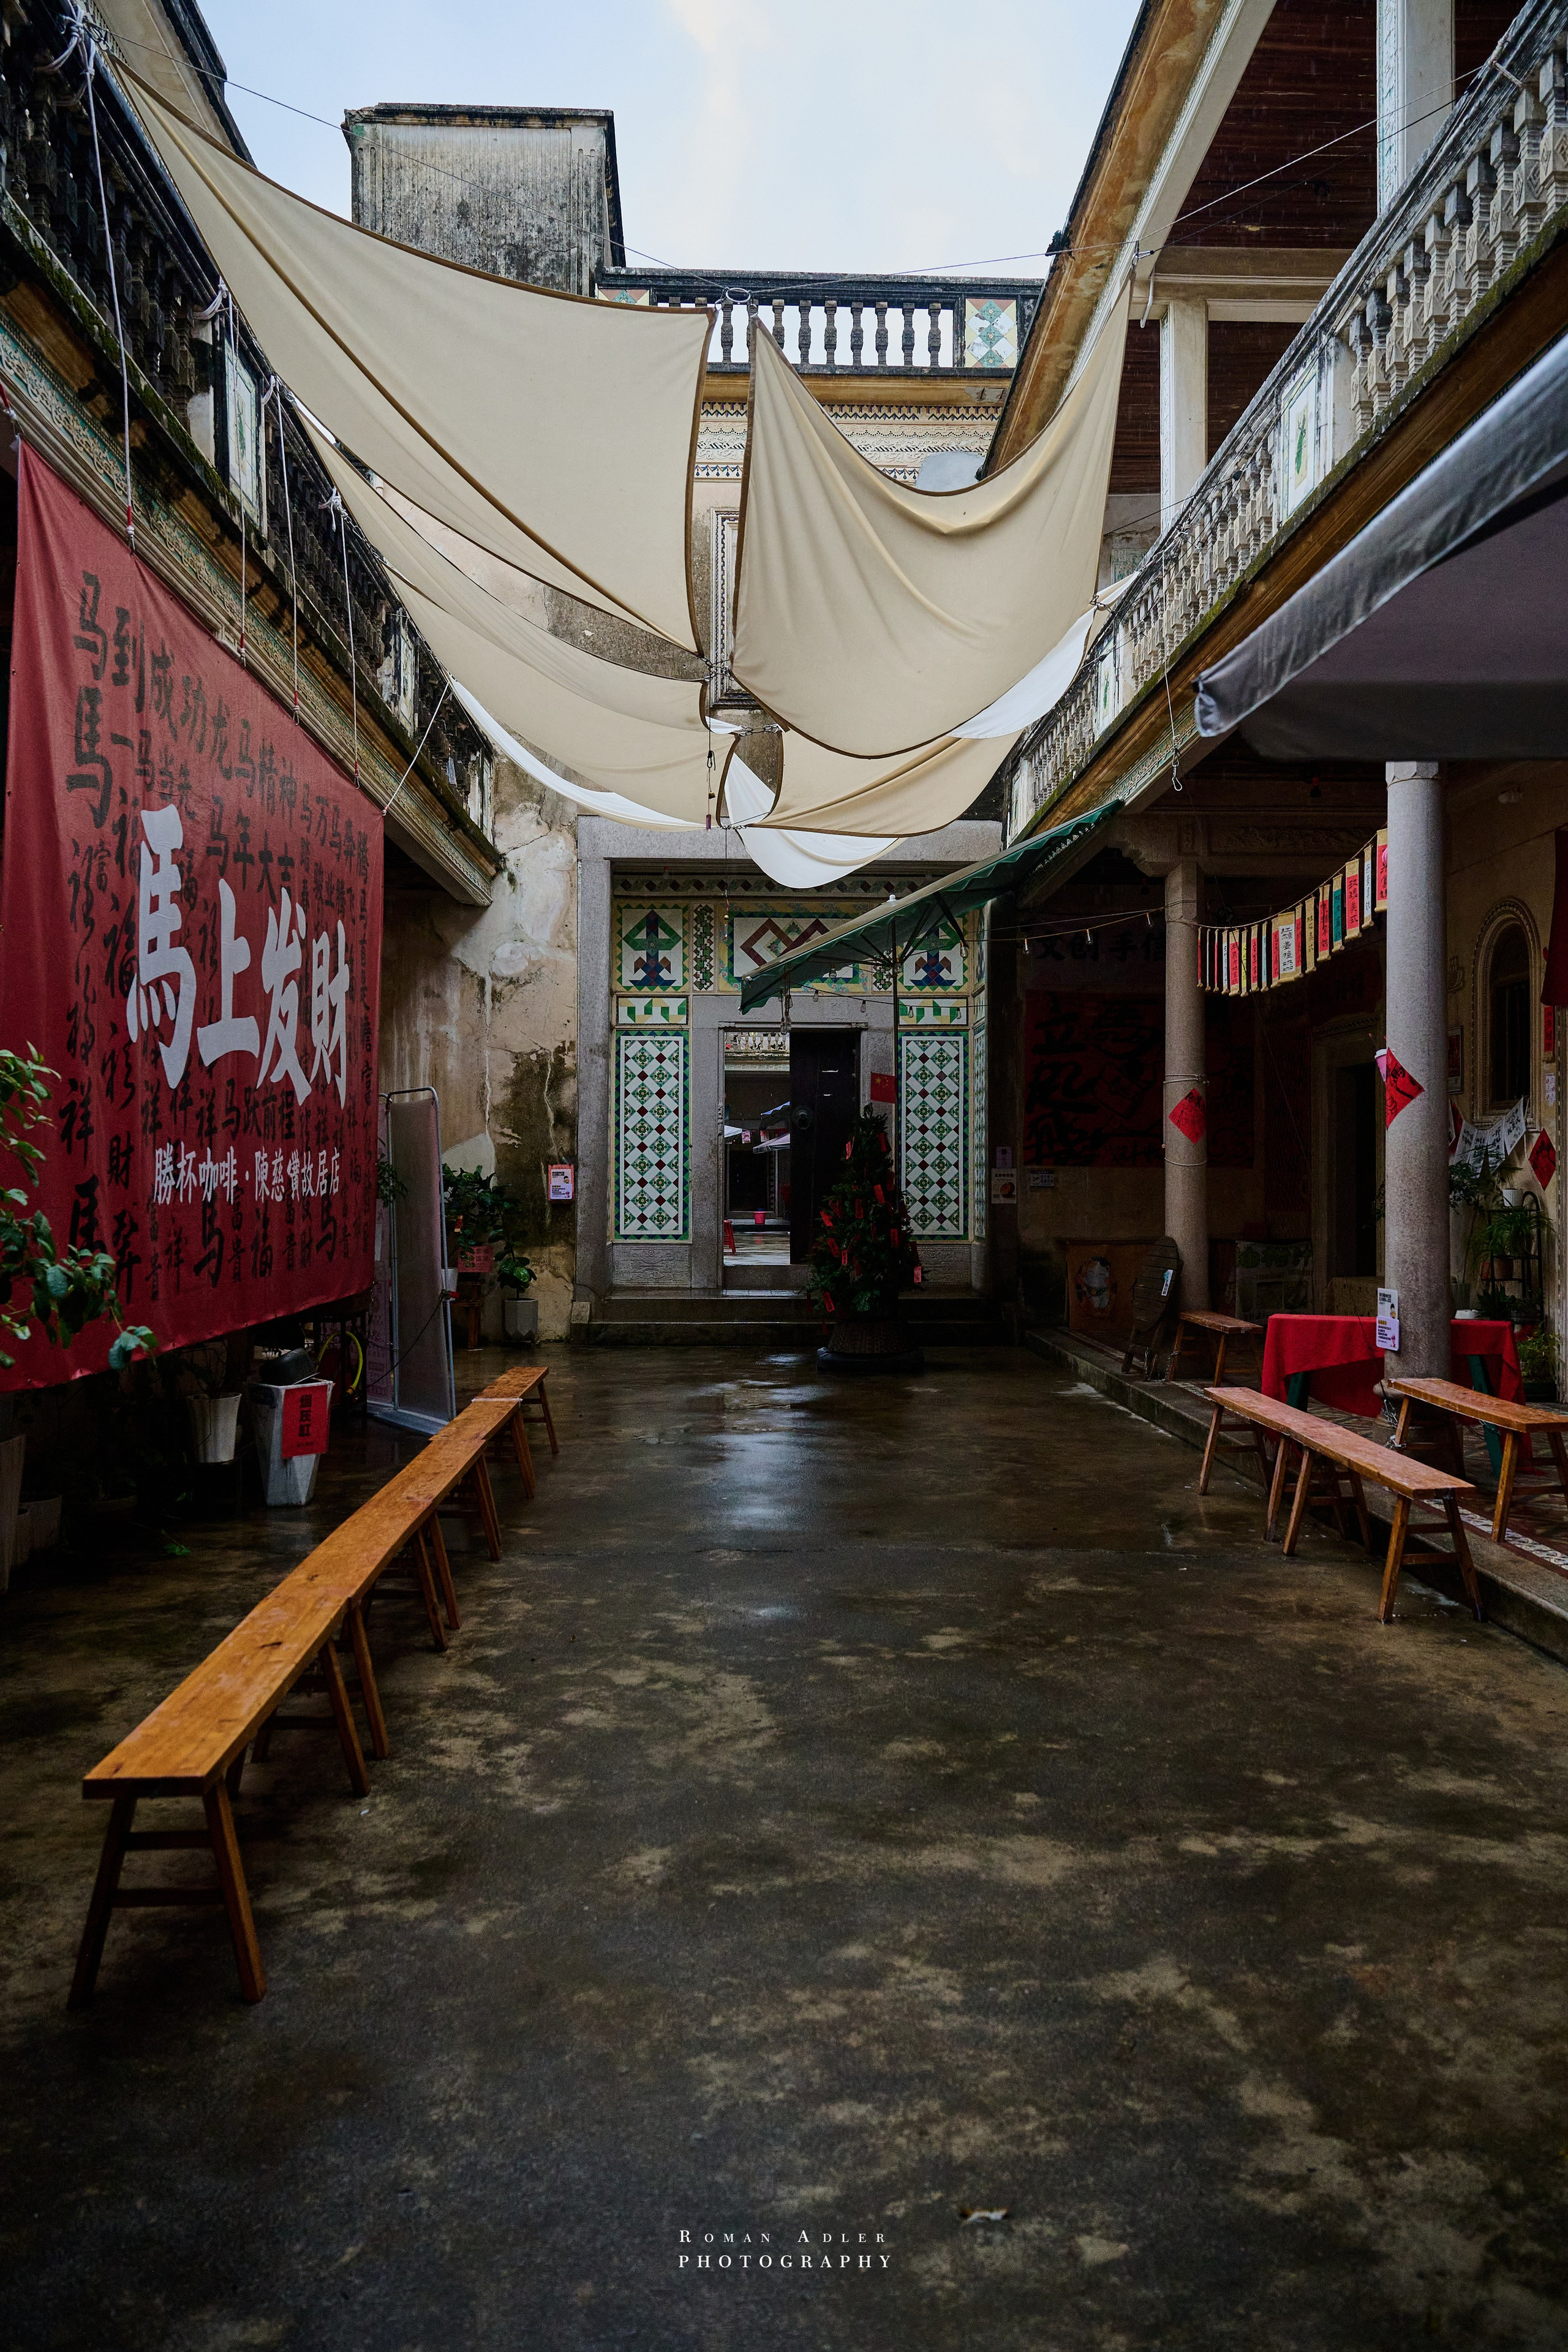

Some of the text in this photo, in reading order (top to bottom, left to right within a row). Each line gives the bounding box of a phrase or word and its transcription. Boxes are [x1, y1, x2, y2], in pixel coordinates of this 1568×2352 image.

[126, 804, 349, 1110] 馬上发財
[1035, 930, 1164, 963] 文创手信
[222, 1078, 296, 1142] 马跃前程
